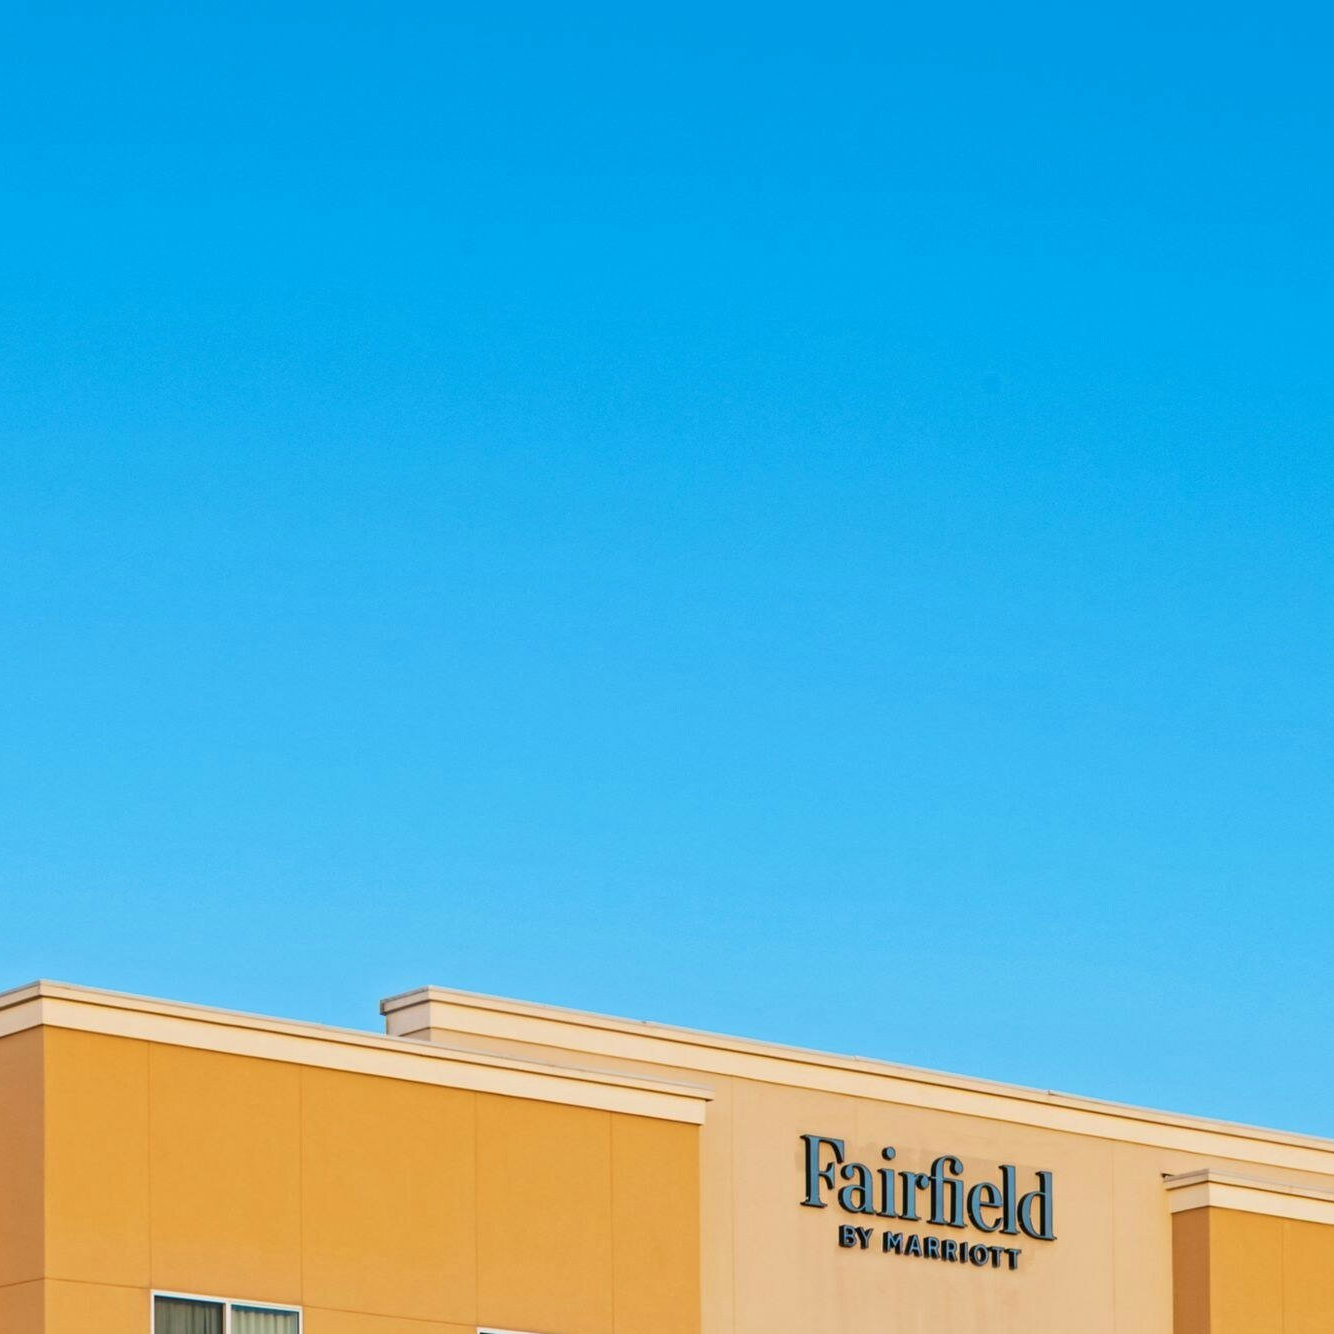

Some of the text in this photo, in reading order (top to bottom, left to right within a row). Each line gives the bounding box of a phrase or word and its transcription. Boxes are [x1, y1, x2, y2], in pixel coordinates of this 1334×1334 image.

[799, 1134, 1057, 1240] Fairfield
[838, 1224, 1021, 1270] BY MARRIOTT
